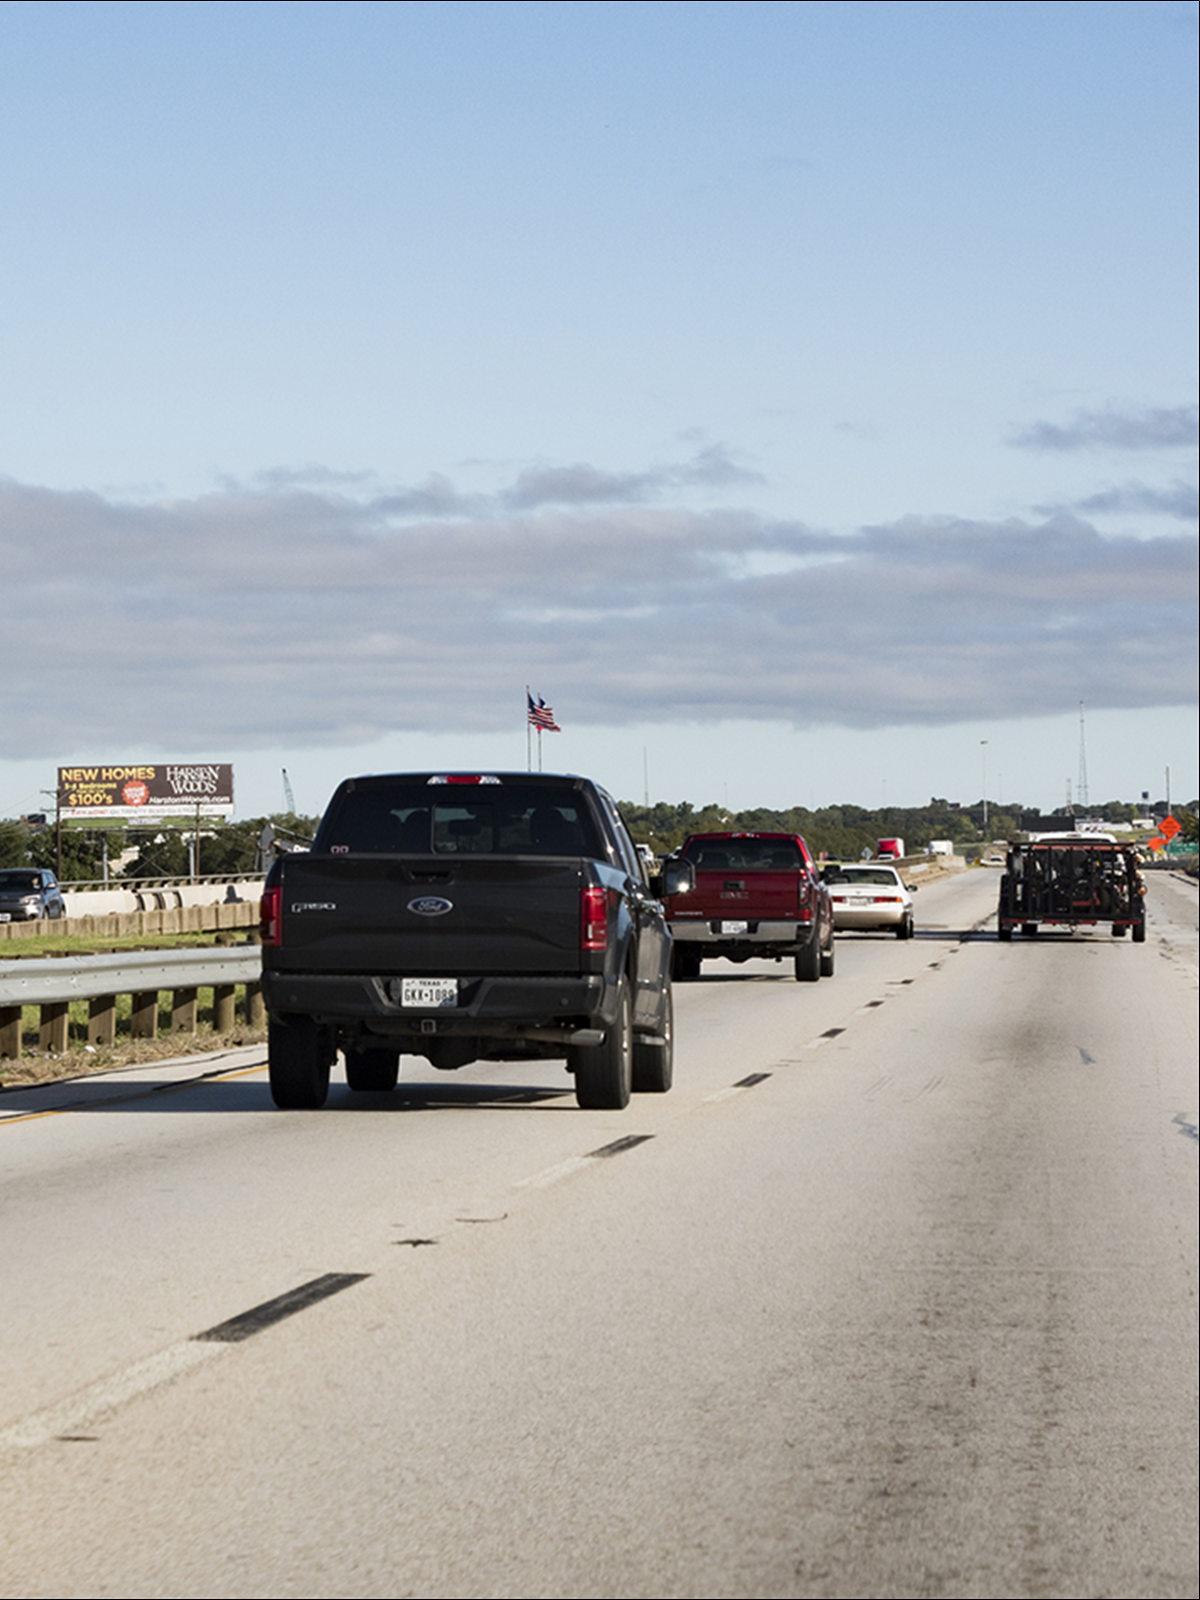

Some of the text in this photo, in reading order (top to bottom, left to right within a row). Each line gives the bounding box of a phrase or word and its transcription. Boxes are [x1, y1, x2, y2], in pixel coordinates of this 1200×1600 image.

[61, 766, 156, 782] NEW HOMES
[79, 782, 117, 790] Bedrooms
[170, 780, 217, 795] WOODS
[68, 793, 113, 806] $100's
[418, 900, 443, 912] Ford
